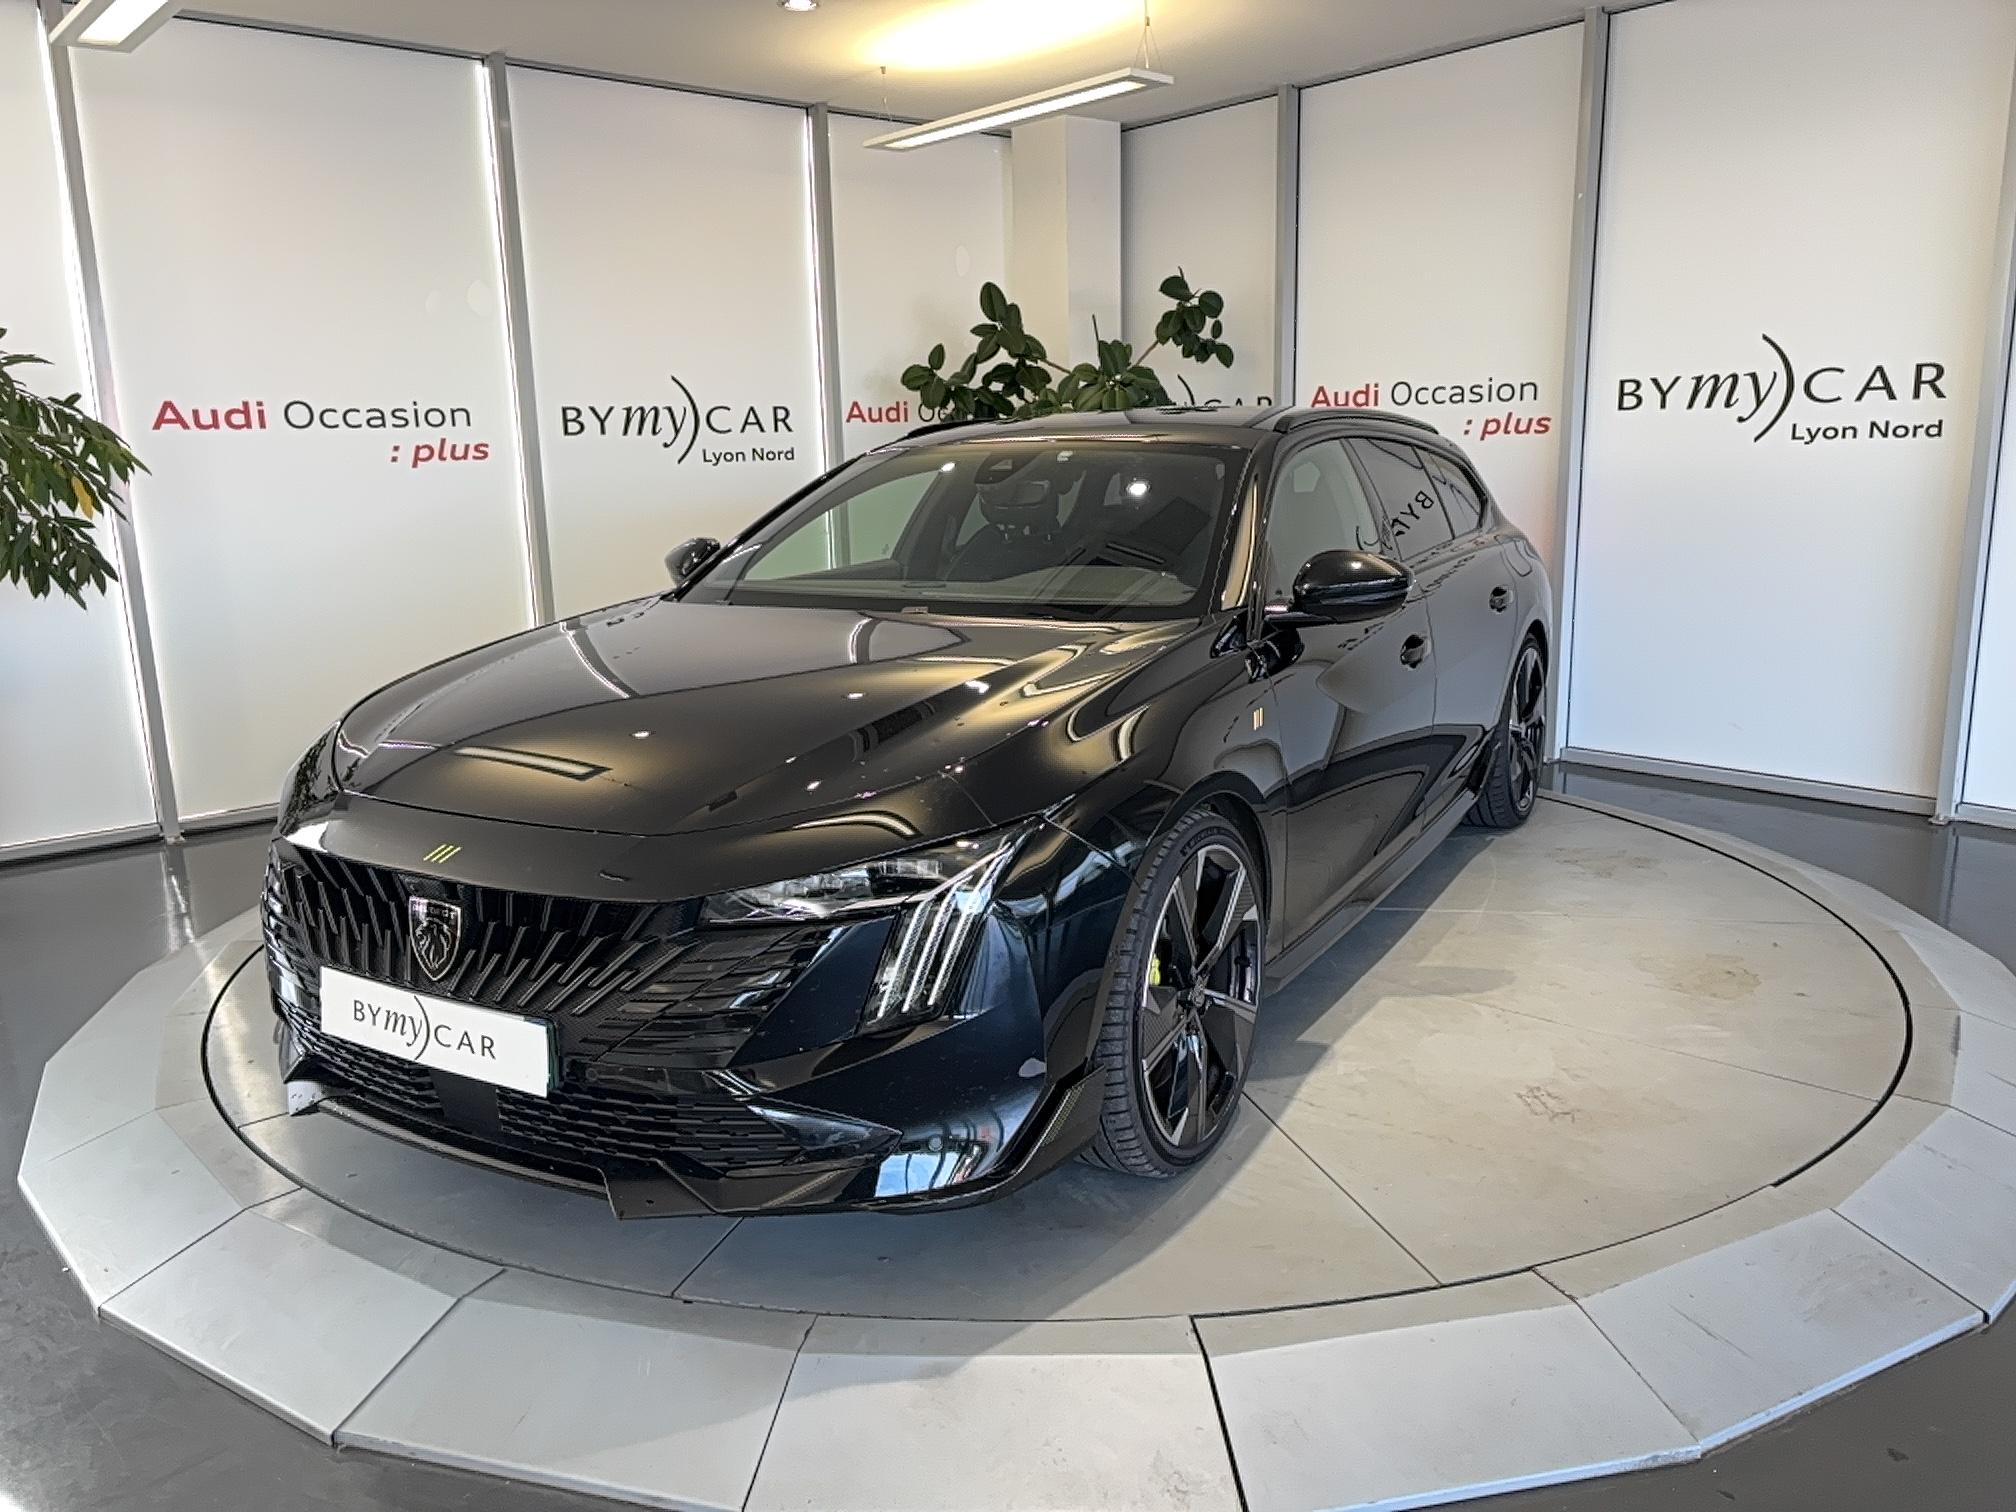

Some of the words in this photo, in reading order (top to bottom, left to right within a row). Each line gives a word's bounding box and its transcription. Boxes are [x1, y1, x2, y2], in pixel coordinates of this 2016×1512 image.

[1311, 383, 1379, 407] Audi
[1391, 377, 1538, 406] Occasion
[152, 400, 267, 430] Audi
[283, 400, 472, 430] Occasion
[846, 401, 908, 423] Audi
[1480, 412, 1552, 441] plus
[1790, 422, 1858, 446] Lyon
[1868, 419, 1944, 440] Nord
[412, 438, 490, 468] plus
[702, 449, 747, 467] Lyon
[751, 447, 795, 462] Nord
